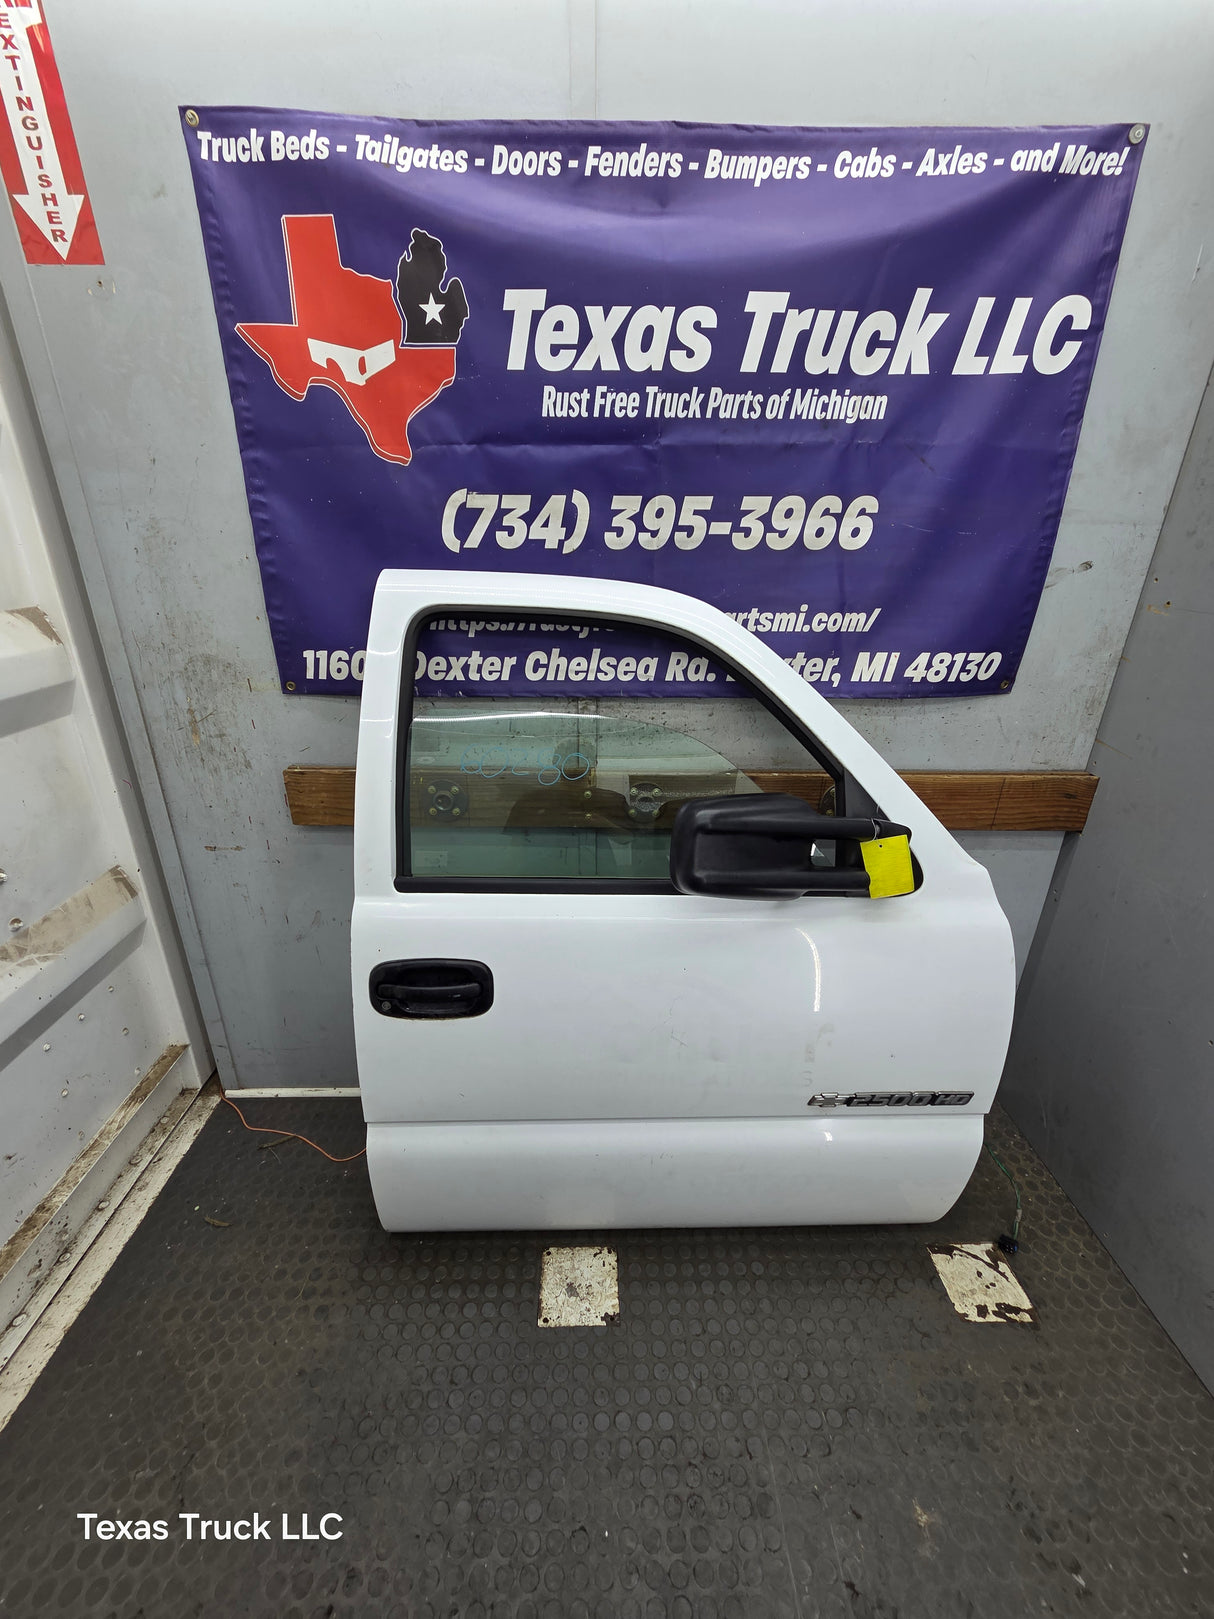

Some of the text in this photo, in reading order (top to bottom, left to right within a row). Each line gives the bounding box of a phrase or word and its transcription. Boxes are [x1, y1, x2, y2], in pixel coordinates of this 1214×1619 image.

[0, 13, 68, 243] EXTINGUISHER
[196, 127, 265, 163] Truck
[270, 128, 331, 161] Beds
[354, 133, 469, 174] Tailgates
[491, 144, 563, 177] Doors
[584, 142, 684, 178] Fenders
[703, 148, 812, 188] Bumpers
[833, 146, 897, 179] Cabs
[915, 147, 989, 178] Axles
[1010, 141, 1058, 174] and
[1058, 144, 1131, 177] More!
[502, 287, 1093, 376] Texas Truck LLC
[541, 385, 888, 424] Rust Free Truck Parts of Michigan
[441, 488, 880, 554] (734) 395-3966
[524, 648, 659, 682] Chelsea
[850, 651, 901, 683] MI
[903, 651, 1003, 683] 48130
[850, 1093, 930, 1106] 2500
